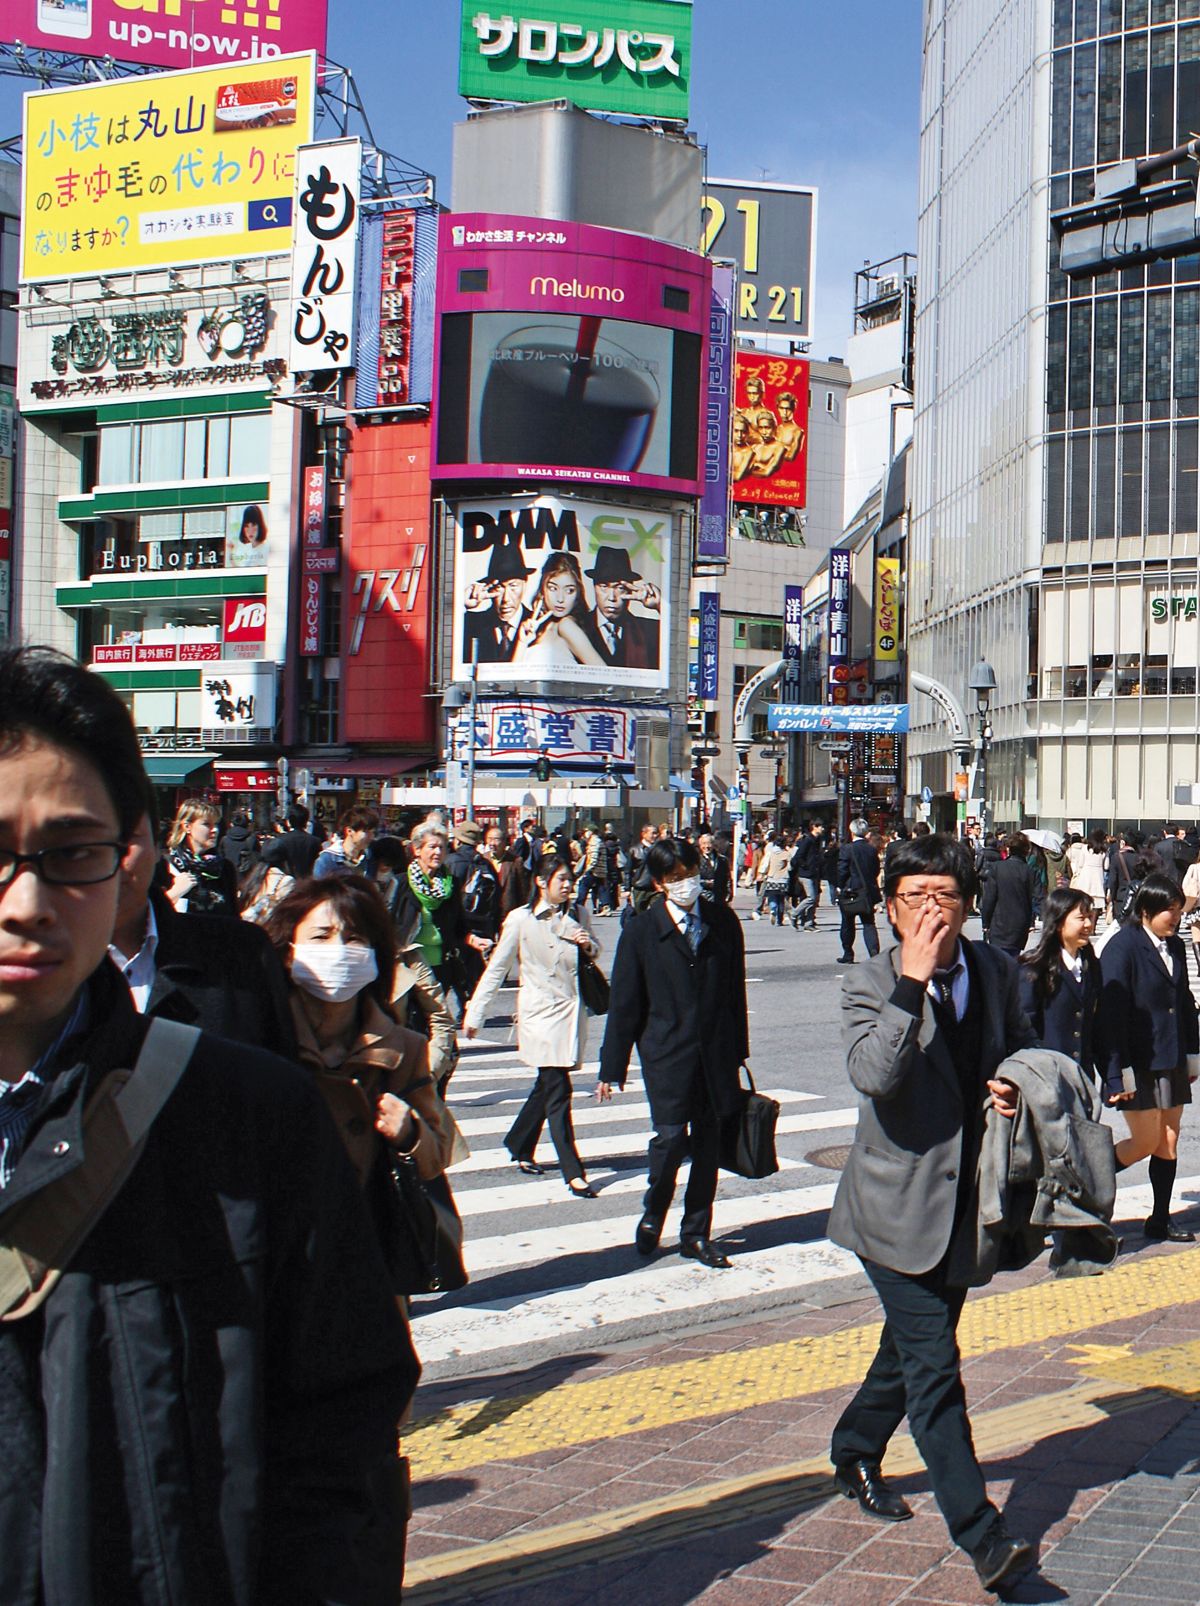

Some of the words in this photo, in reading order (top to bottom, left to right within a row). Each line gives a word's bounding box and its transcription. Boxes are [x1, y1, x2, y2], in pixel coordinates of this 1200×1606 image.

[108, 19, 281, 59] up-now.jp
[472, 12, 680, 76] サロンパス
[37, 95, 206, 157] 小枝は丸山
[37, 145, 294, 212] のまゆ毛の代わりに
[144, 210, 235, 235] オカシな実験室
[466, 230, 514, 243] わかさ生活
[516, 231, 567, 244] チャンネル
[295, 165, 355, 362] もんじゃ
[768, 285, 803, 323] 21
[518, 467, 553, 477] WAKASA
[554, 469, 592, 479] SEIKATSU
[593, 472, 631, 482] CHANNEL
[307, 471, 323, 545] お好み焼
[463, 508, 580, 553] DMM
[590, 516, 665, 563] FX
[102, 546, 218, 573] Euphoria
[228, 602, 266, 633] JTB
[304, 577, 318, 652] もんじゃ焼
[350, 544, 427, 656] クスリ
[830, 554, 849, 656] 洋服の青山
[97, 649, 131, 661] 国内旅行
[138, 647, 174, 660] 海外旅行
[180, 651, 220, 661] ウエディング
[183, 644, 217, 652] ハネムーン
[702, 599, 718, 693] 大盛堂商事ビル
[784, 597, 801, 704] 洋服の青山
[880, 638, 894, 649] 4F
[457, 712, 636, 752] 大盛堂書
